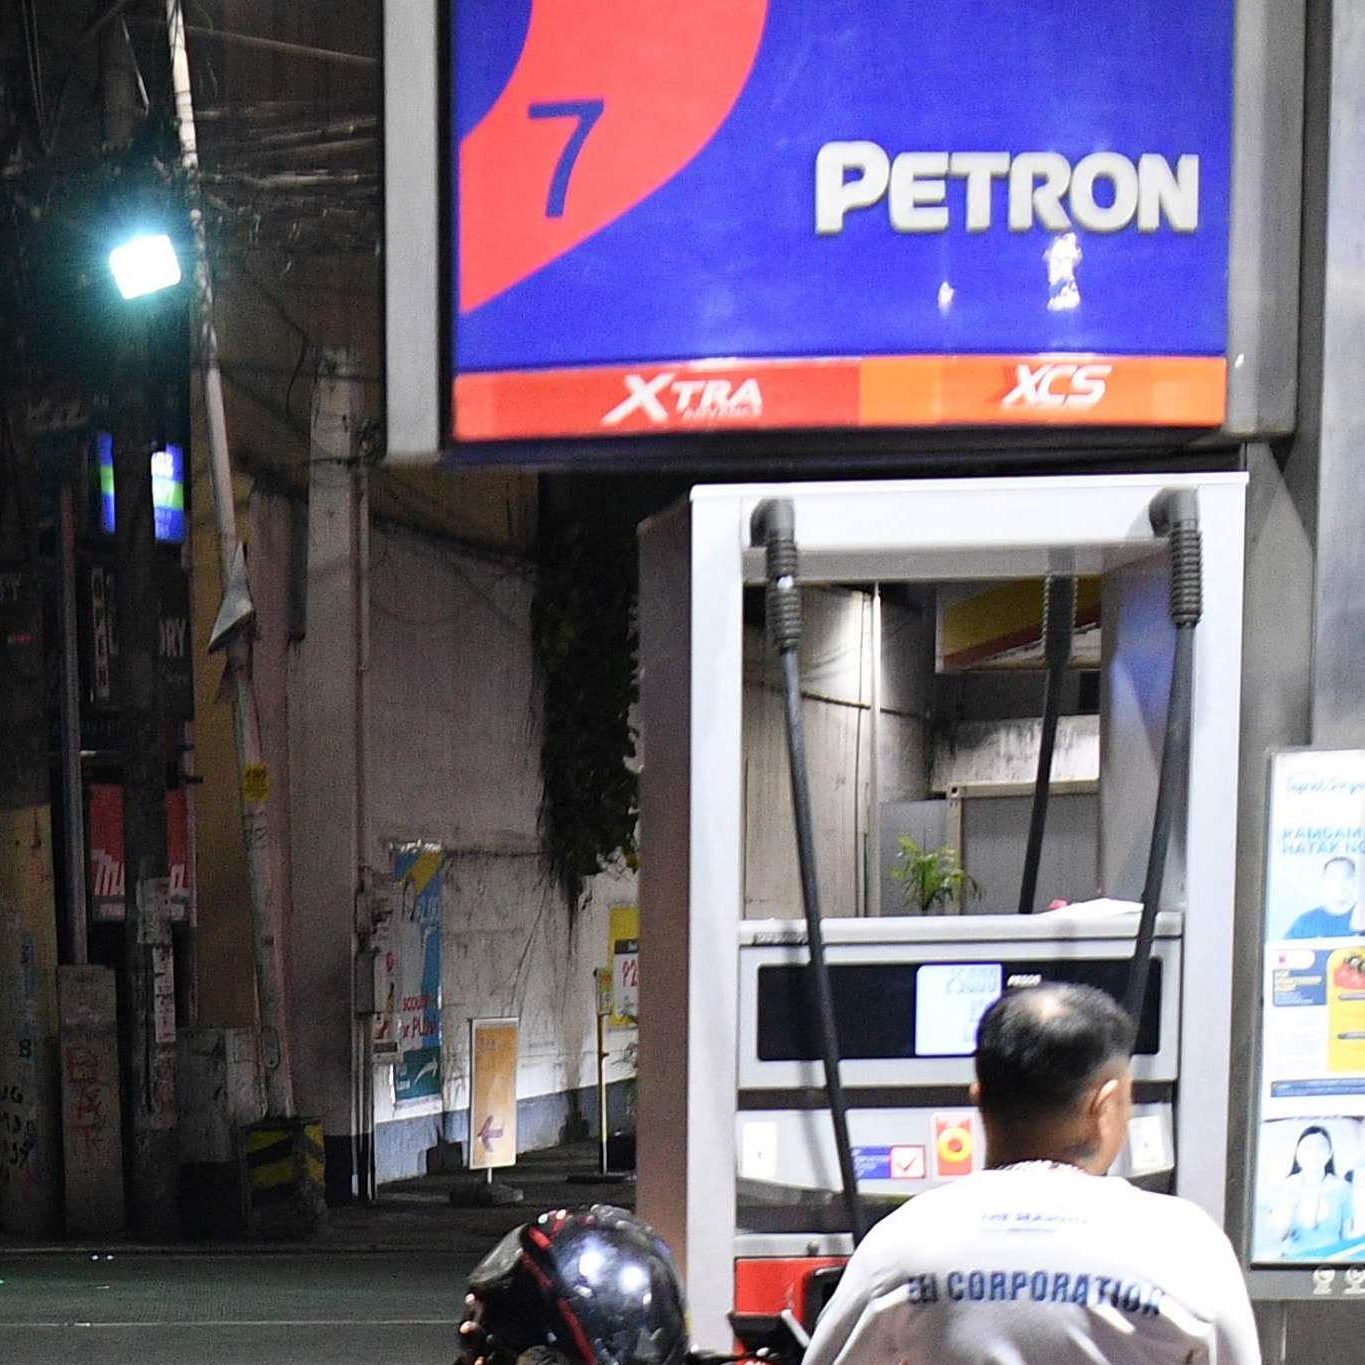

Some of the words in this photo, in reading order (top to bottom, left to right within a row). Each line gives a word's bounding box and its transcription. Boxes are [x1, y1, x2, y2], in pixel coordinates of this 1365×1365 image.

[527, 99, 605, 218] 7
[815, 140, 1199, 235] PETRON
[600, 372, 763, 425] XTRA
[1000, 363, 1113, 411] XCS
[946, 1269, 1166, 1317] CORPORATION
